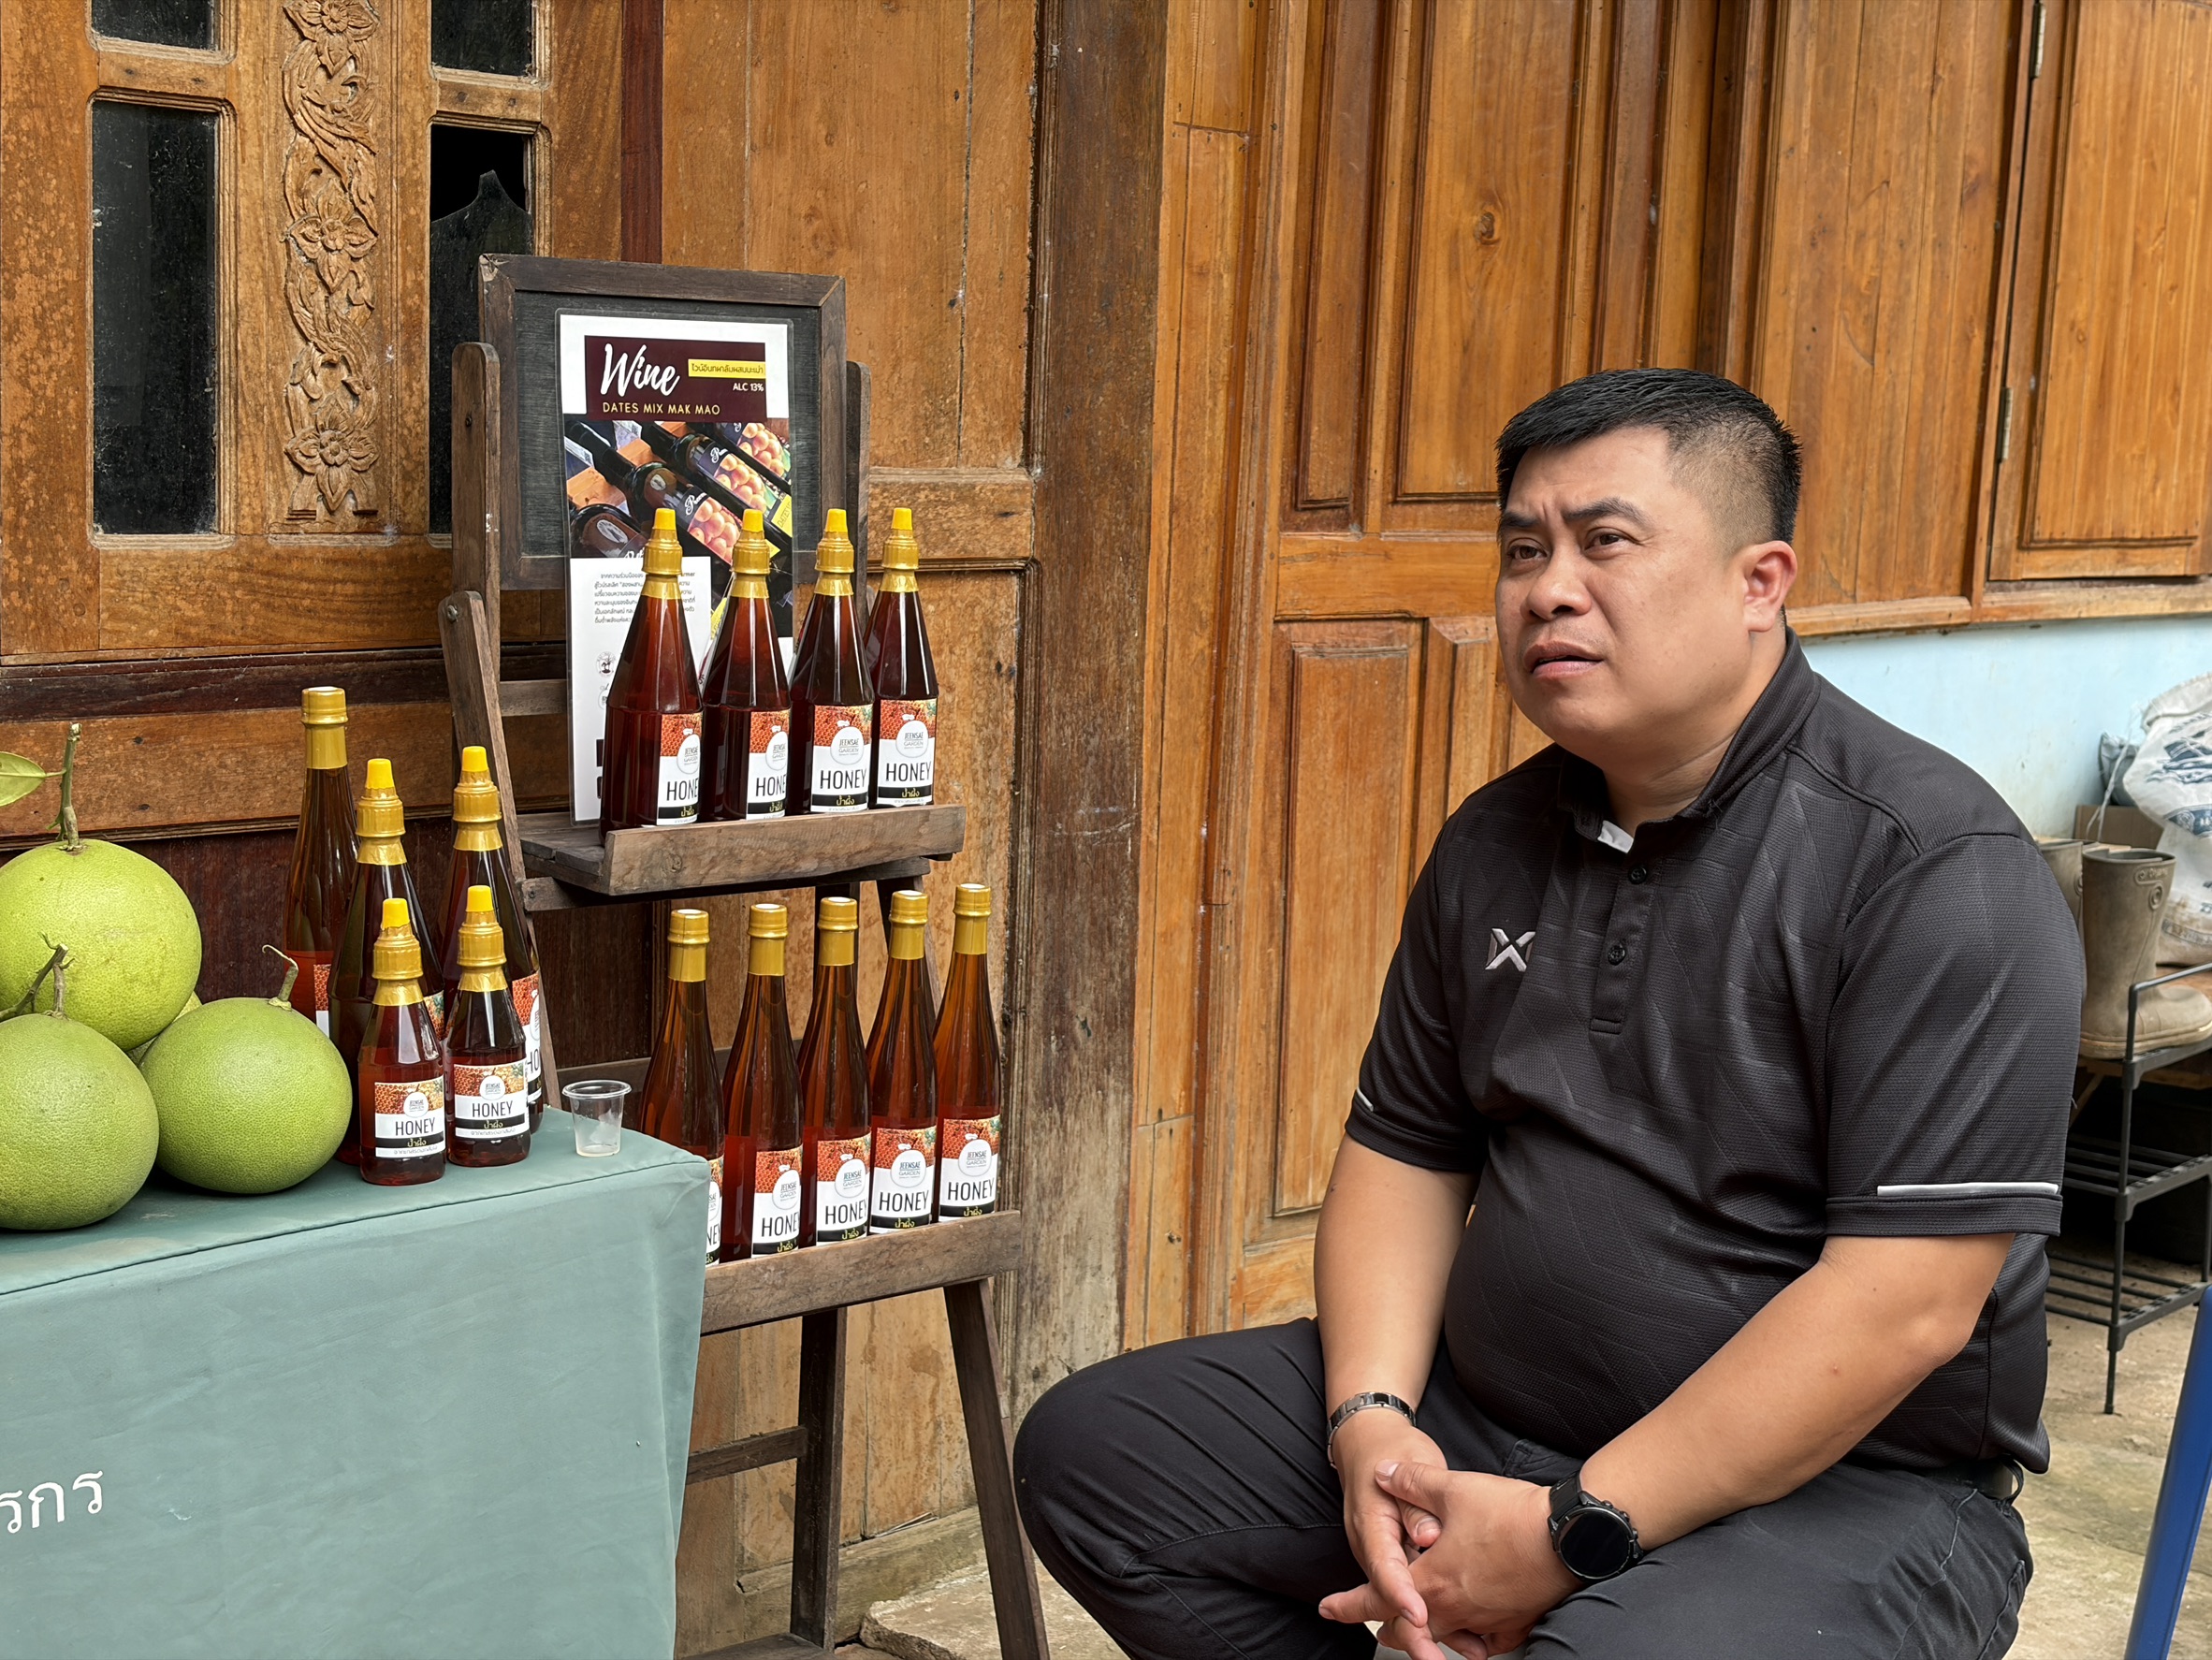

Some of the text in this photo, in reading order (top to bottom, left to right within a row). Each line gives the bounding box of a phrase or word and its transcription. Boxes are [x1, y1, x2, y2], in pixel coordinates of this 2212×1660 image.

[600, 342, 680, 397] Wine
[733, 382, 764, 392] ALC 13%
[603, 401, 720, 415] DATES MIX MAK MAO
[820, 768, 866, 790] HONEY
[885, 761, 931, 782] HONEY
[666, 778, 698, 801] HONE
[755, 774, 786, 796] HONE
[472, 1100, 513, 1117] HONEY
[395, 1116, 436, 1136] HONEY
[948, 1177, 995, 1201] HONEY
[879, 1189, 929, 1212] HONEY
[761, 1212, 799, 1237] HONE
